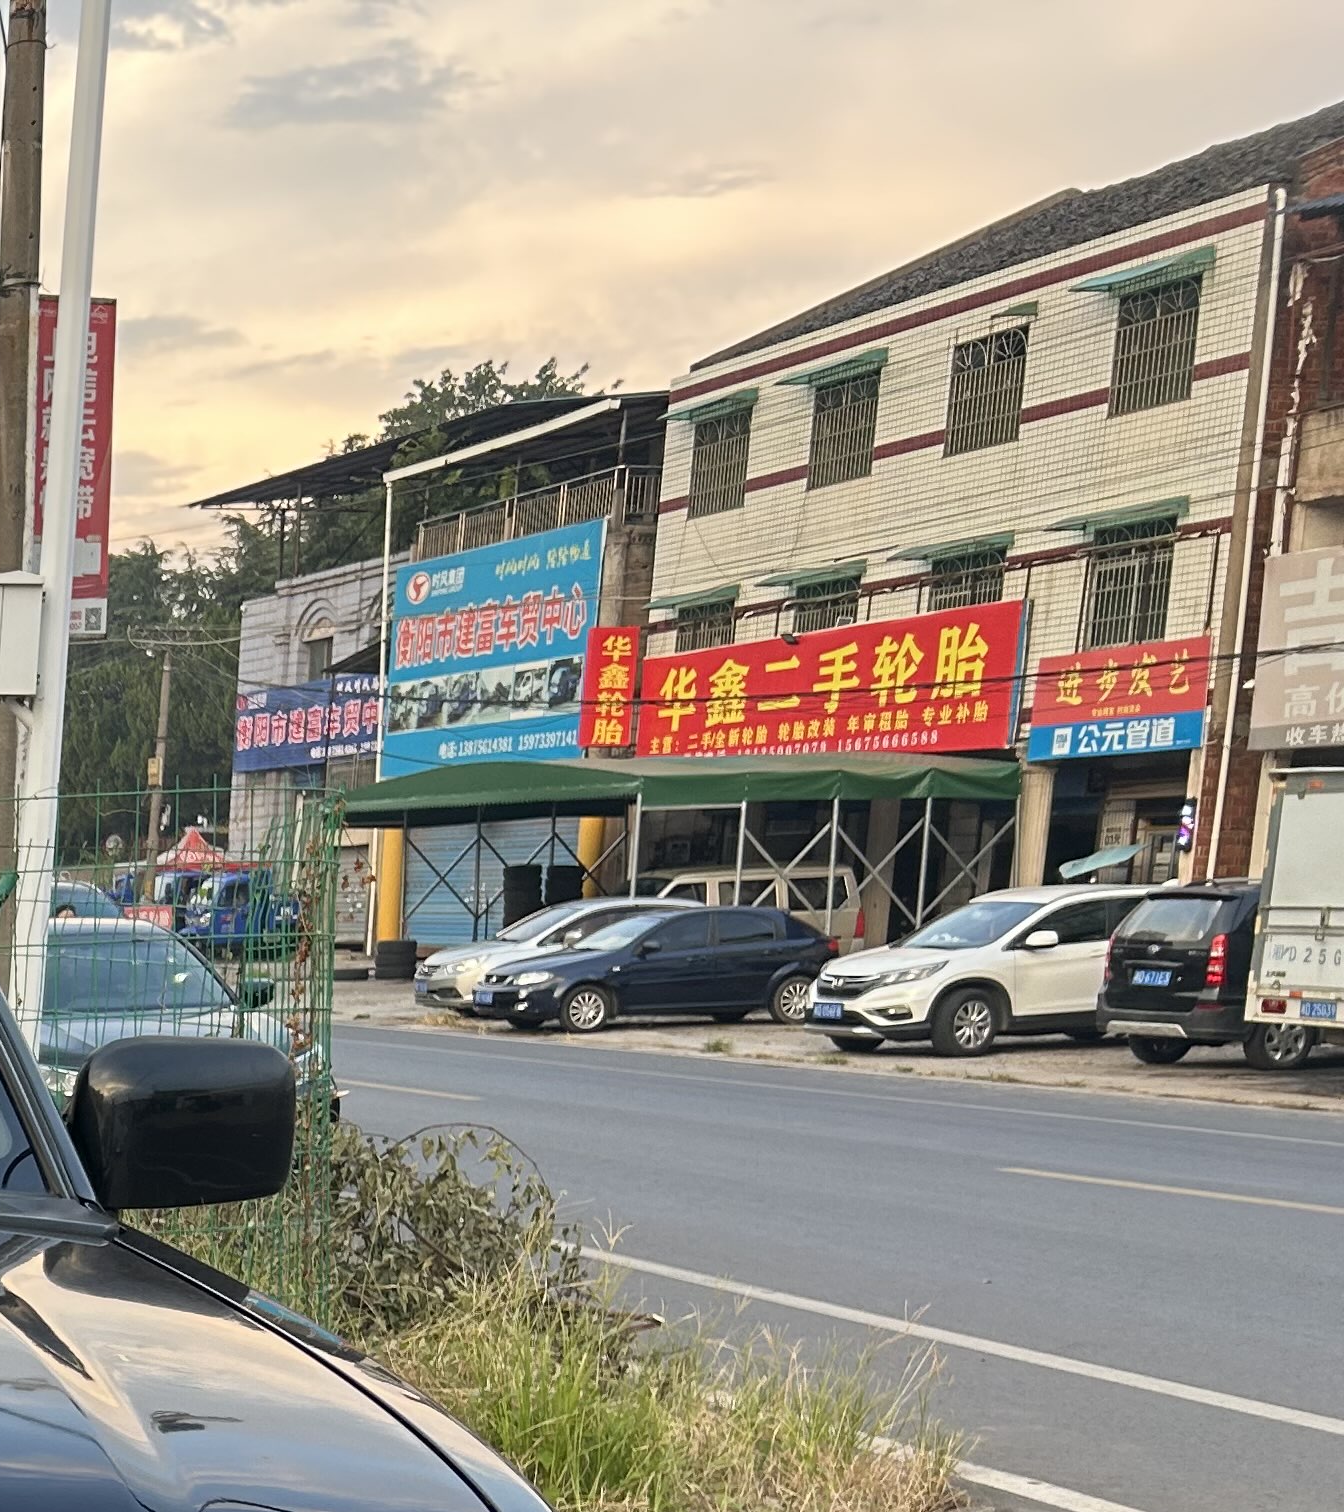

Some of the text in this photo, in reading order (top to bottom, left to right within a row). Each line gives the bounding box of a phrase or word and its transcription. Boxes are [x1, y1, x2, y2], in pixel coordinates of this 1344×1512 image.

[395, 582, 588, 671] 衡阳市建富车贸中心
[591, 635, 632, 746] 华鑫轮胎
[658, 622, 990, 732] 华鑫二手轮胎
[920, 699, 990, 727] 专业补胎
[1077, 717, 1176, 754] 公元管道
